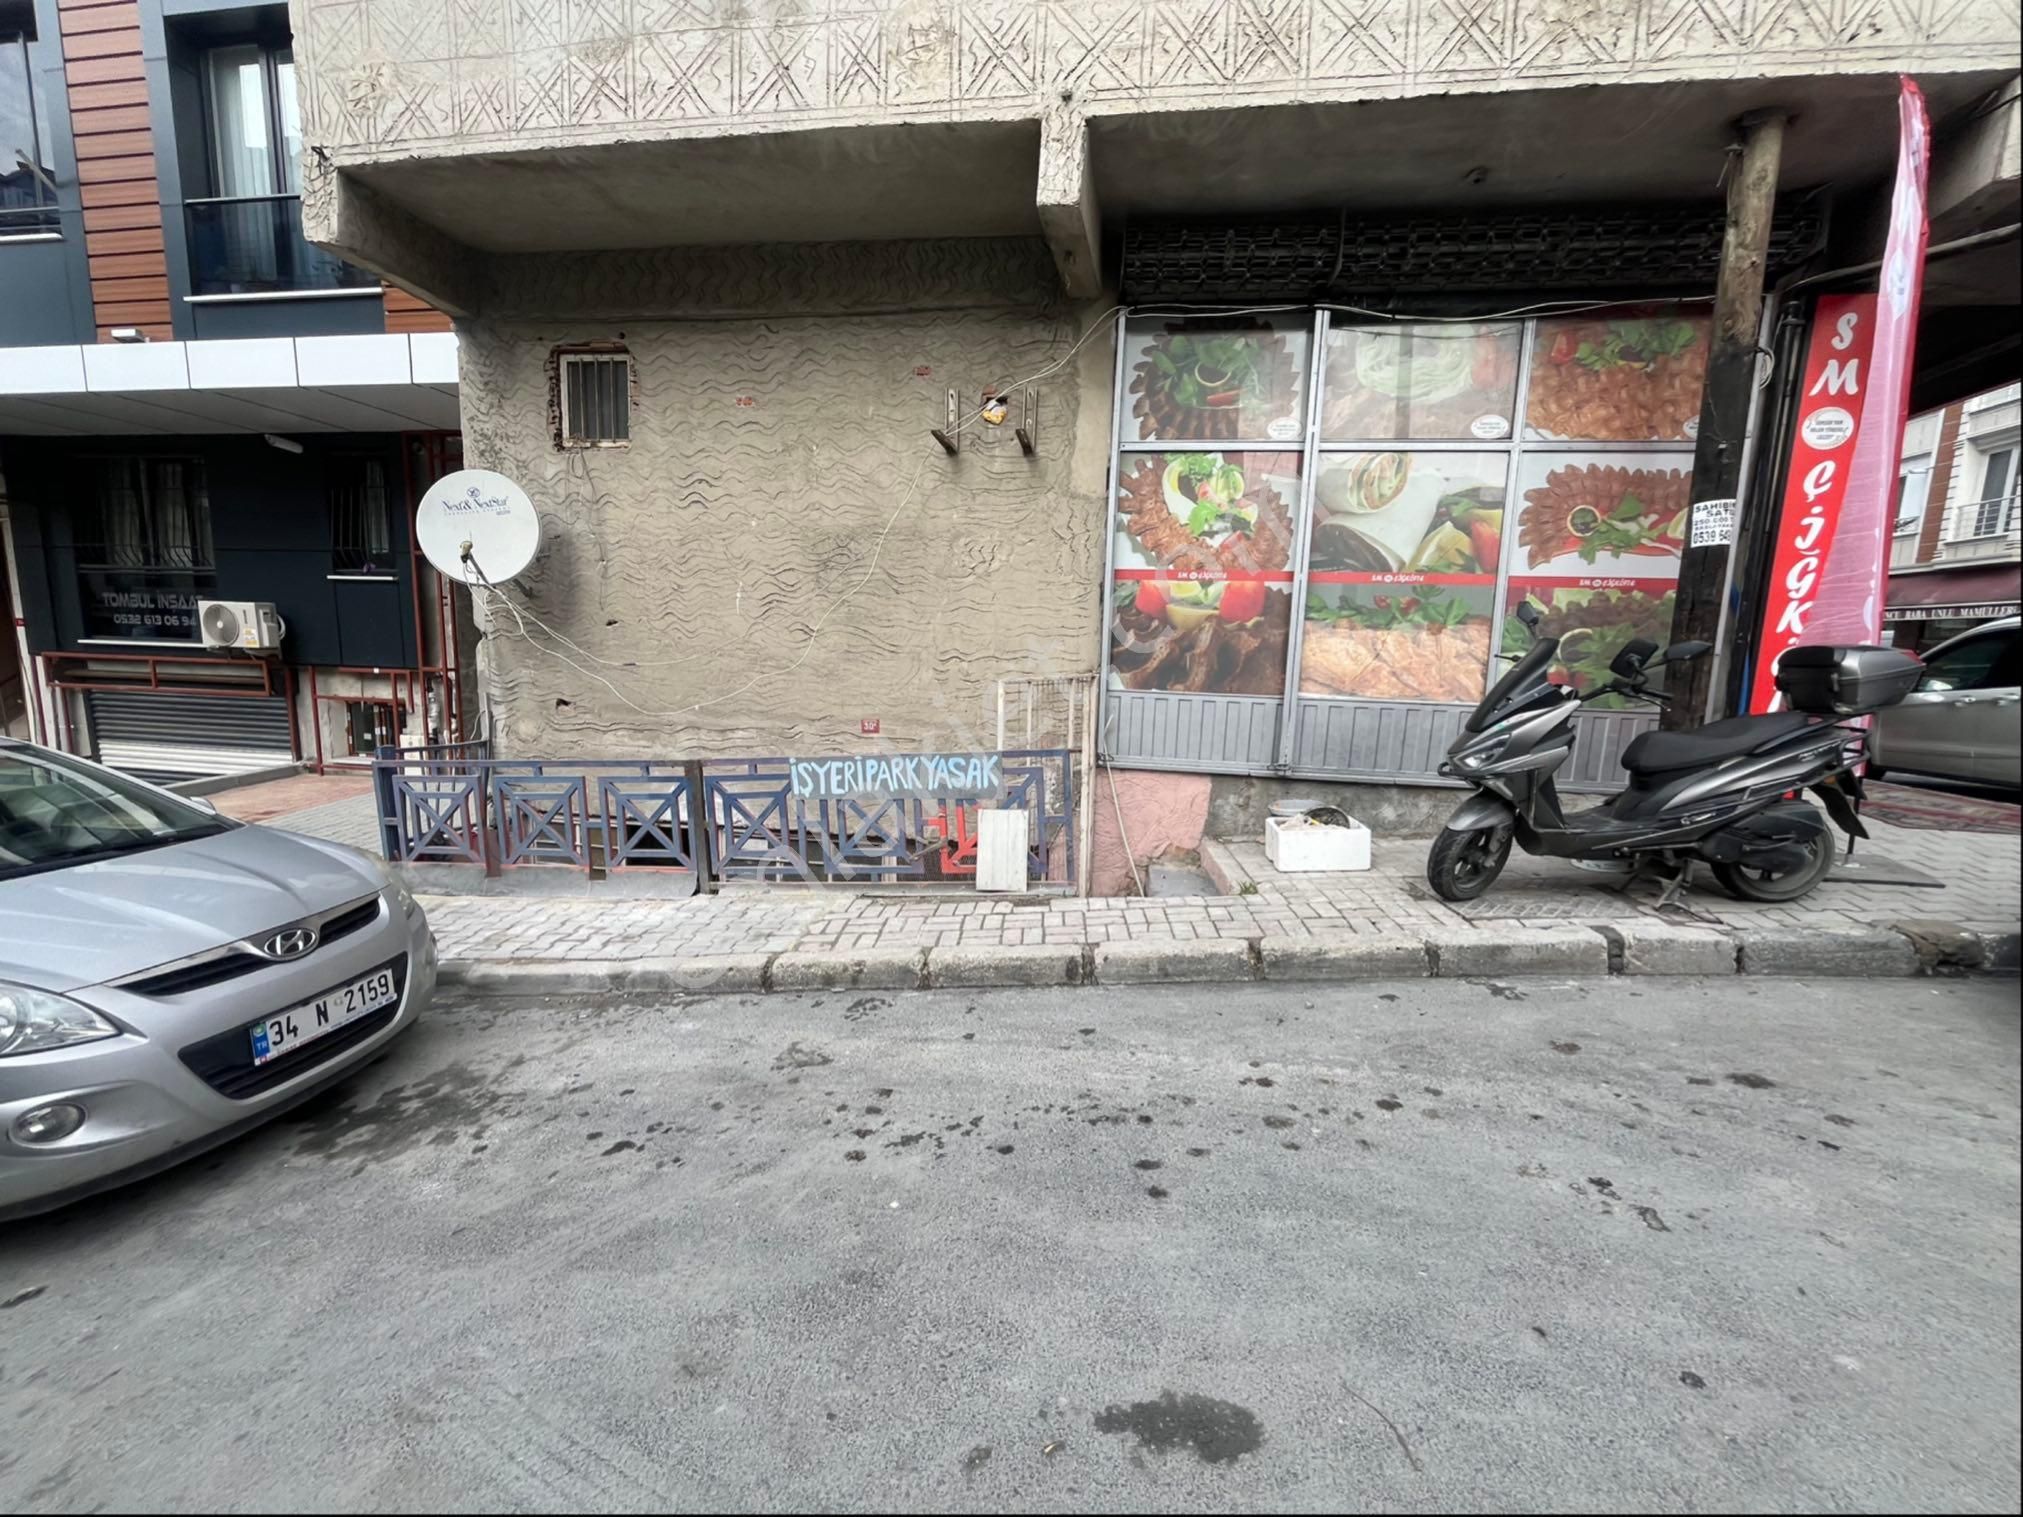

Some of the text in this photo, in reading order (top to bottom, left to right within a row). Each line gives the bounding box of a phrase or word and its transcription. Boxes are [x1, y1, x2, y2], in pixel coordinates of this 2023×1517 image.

[102, 592, 155, 608] TOMBUL
[164, 615, 179, 626] 06
[269, 1015, 299, 1047] 34
[315, 1000, 329, 1027] N
[344, 974, 390, 1014] 2159
